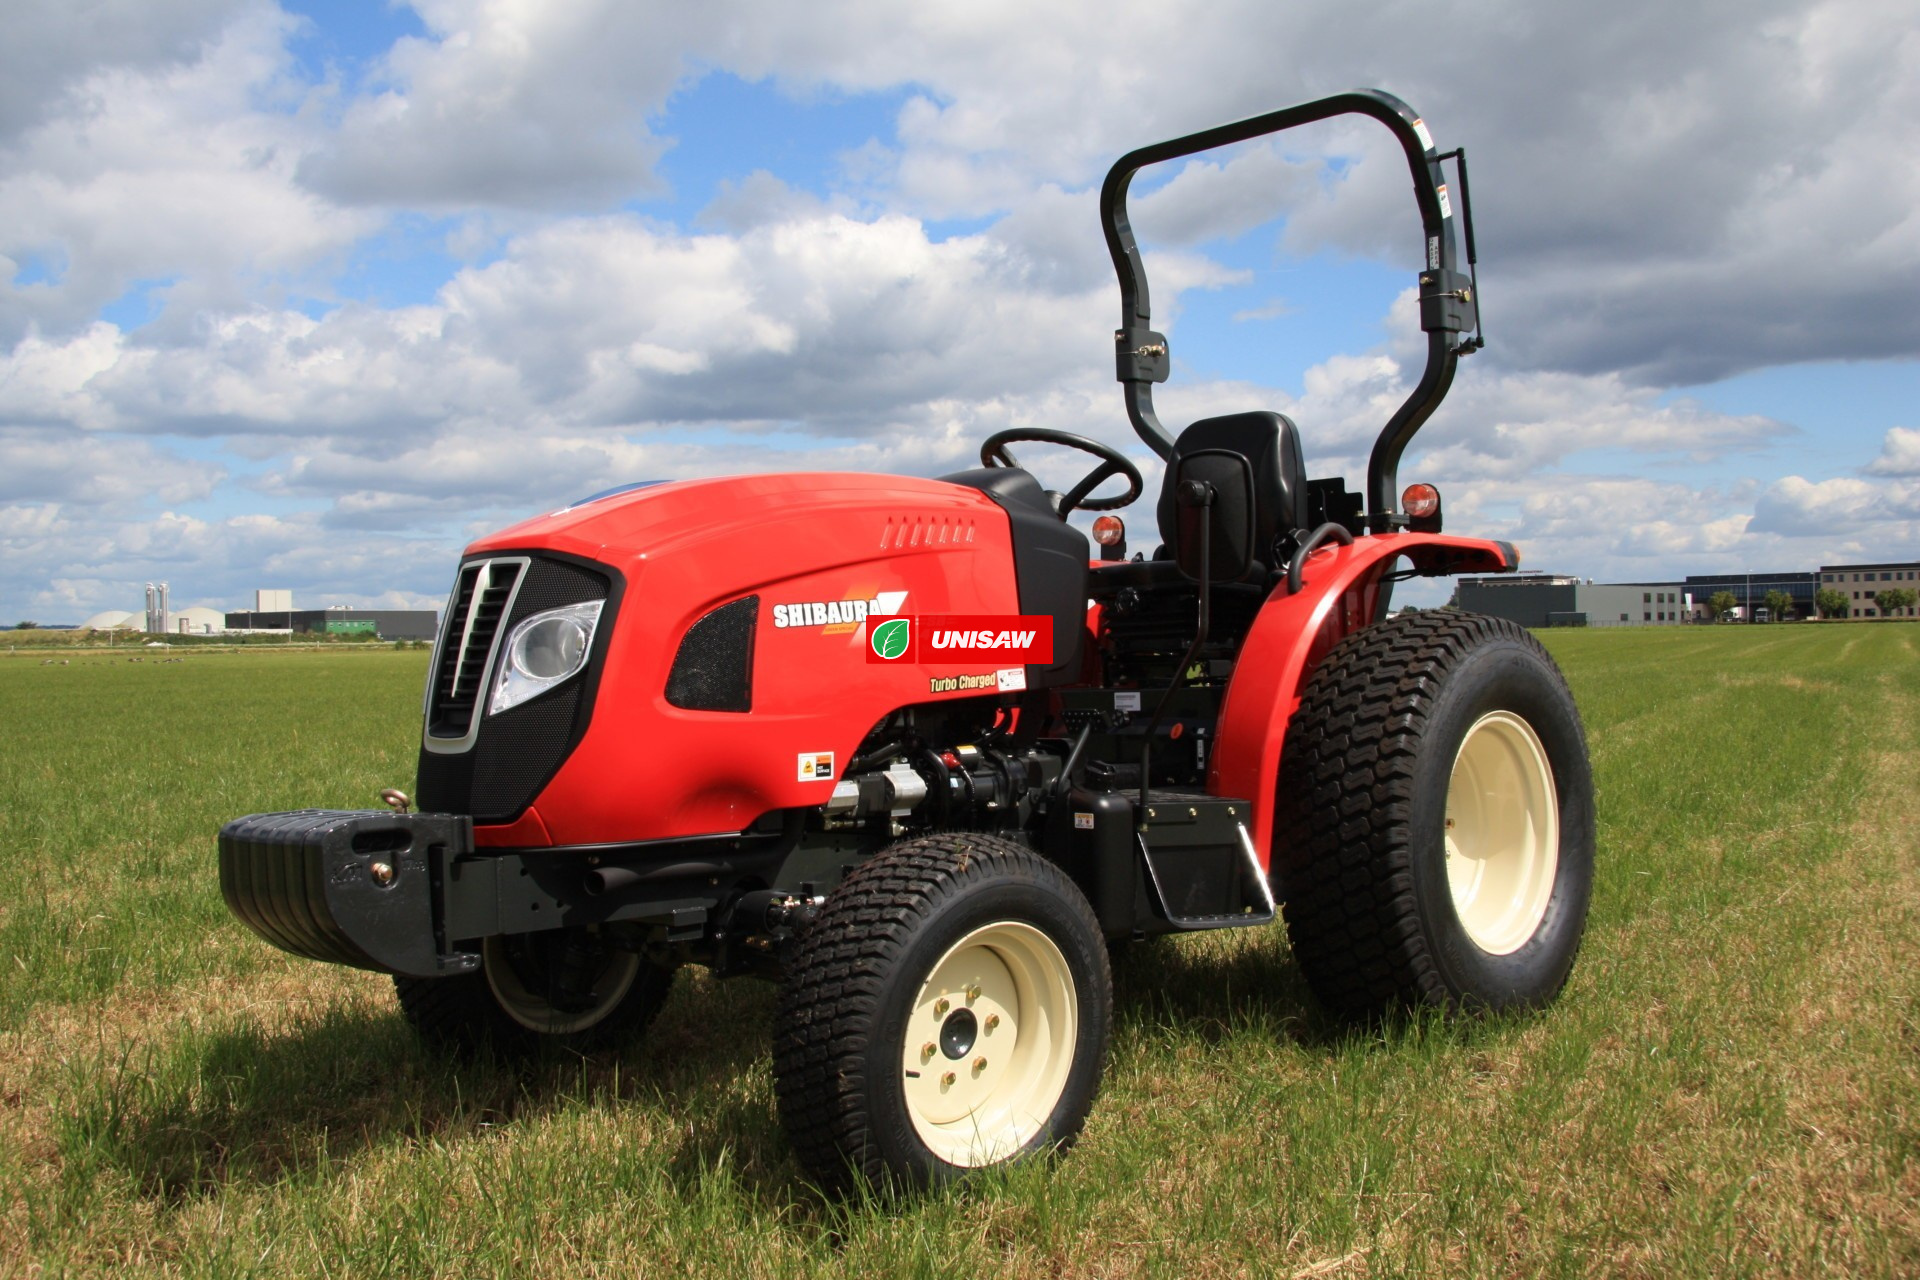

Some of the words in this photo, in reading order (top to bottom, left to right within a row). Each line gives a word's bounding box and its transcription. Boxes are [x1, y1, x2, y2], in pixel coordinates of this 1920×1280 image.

[773, 599, 882, 628] SHIBAURA
[930, 677, 957, 693] Turbo
[959, 672, 996, 690] Charged
